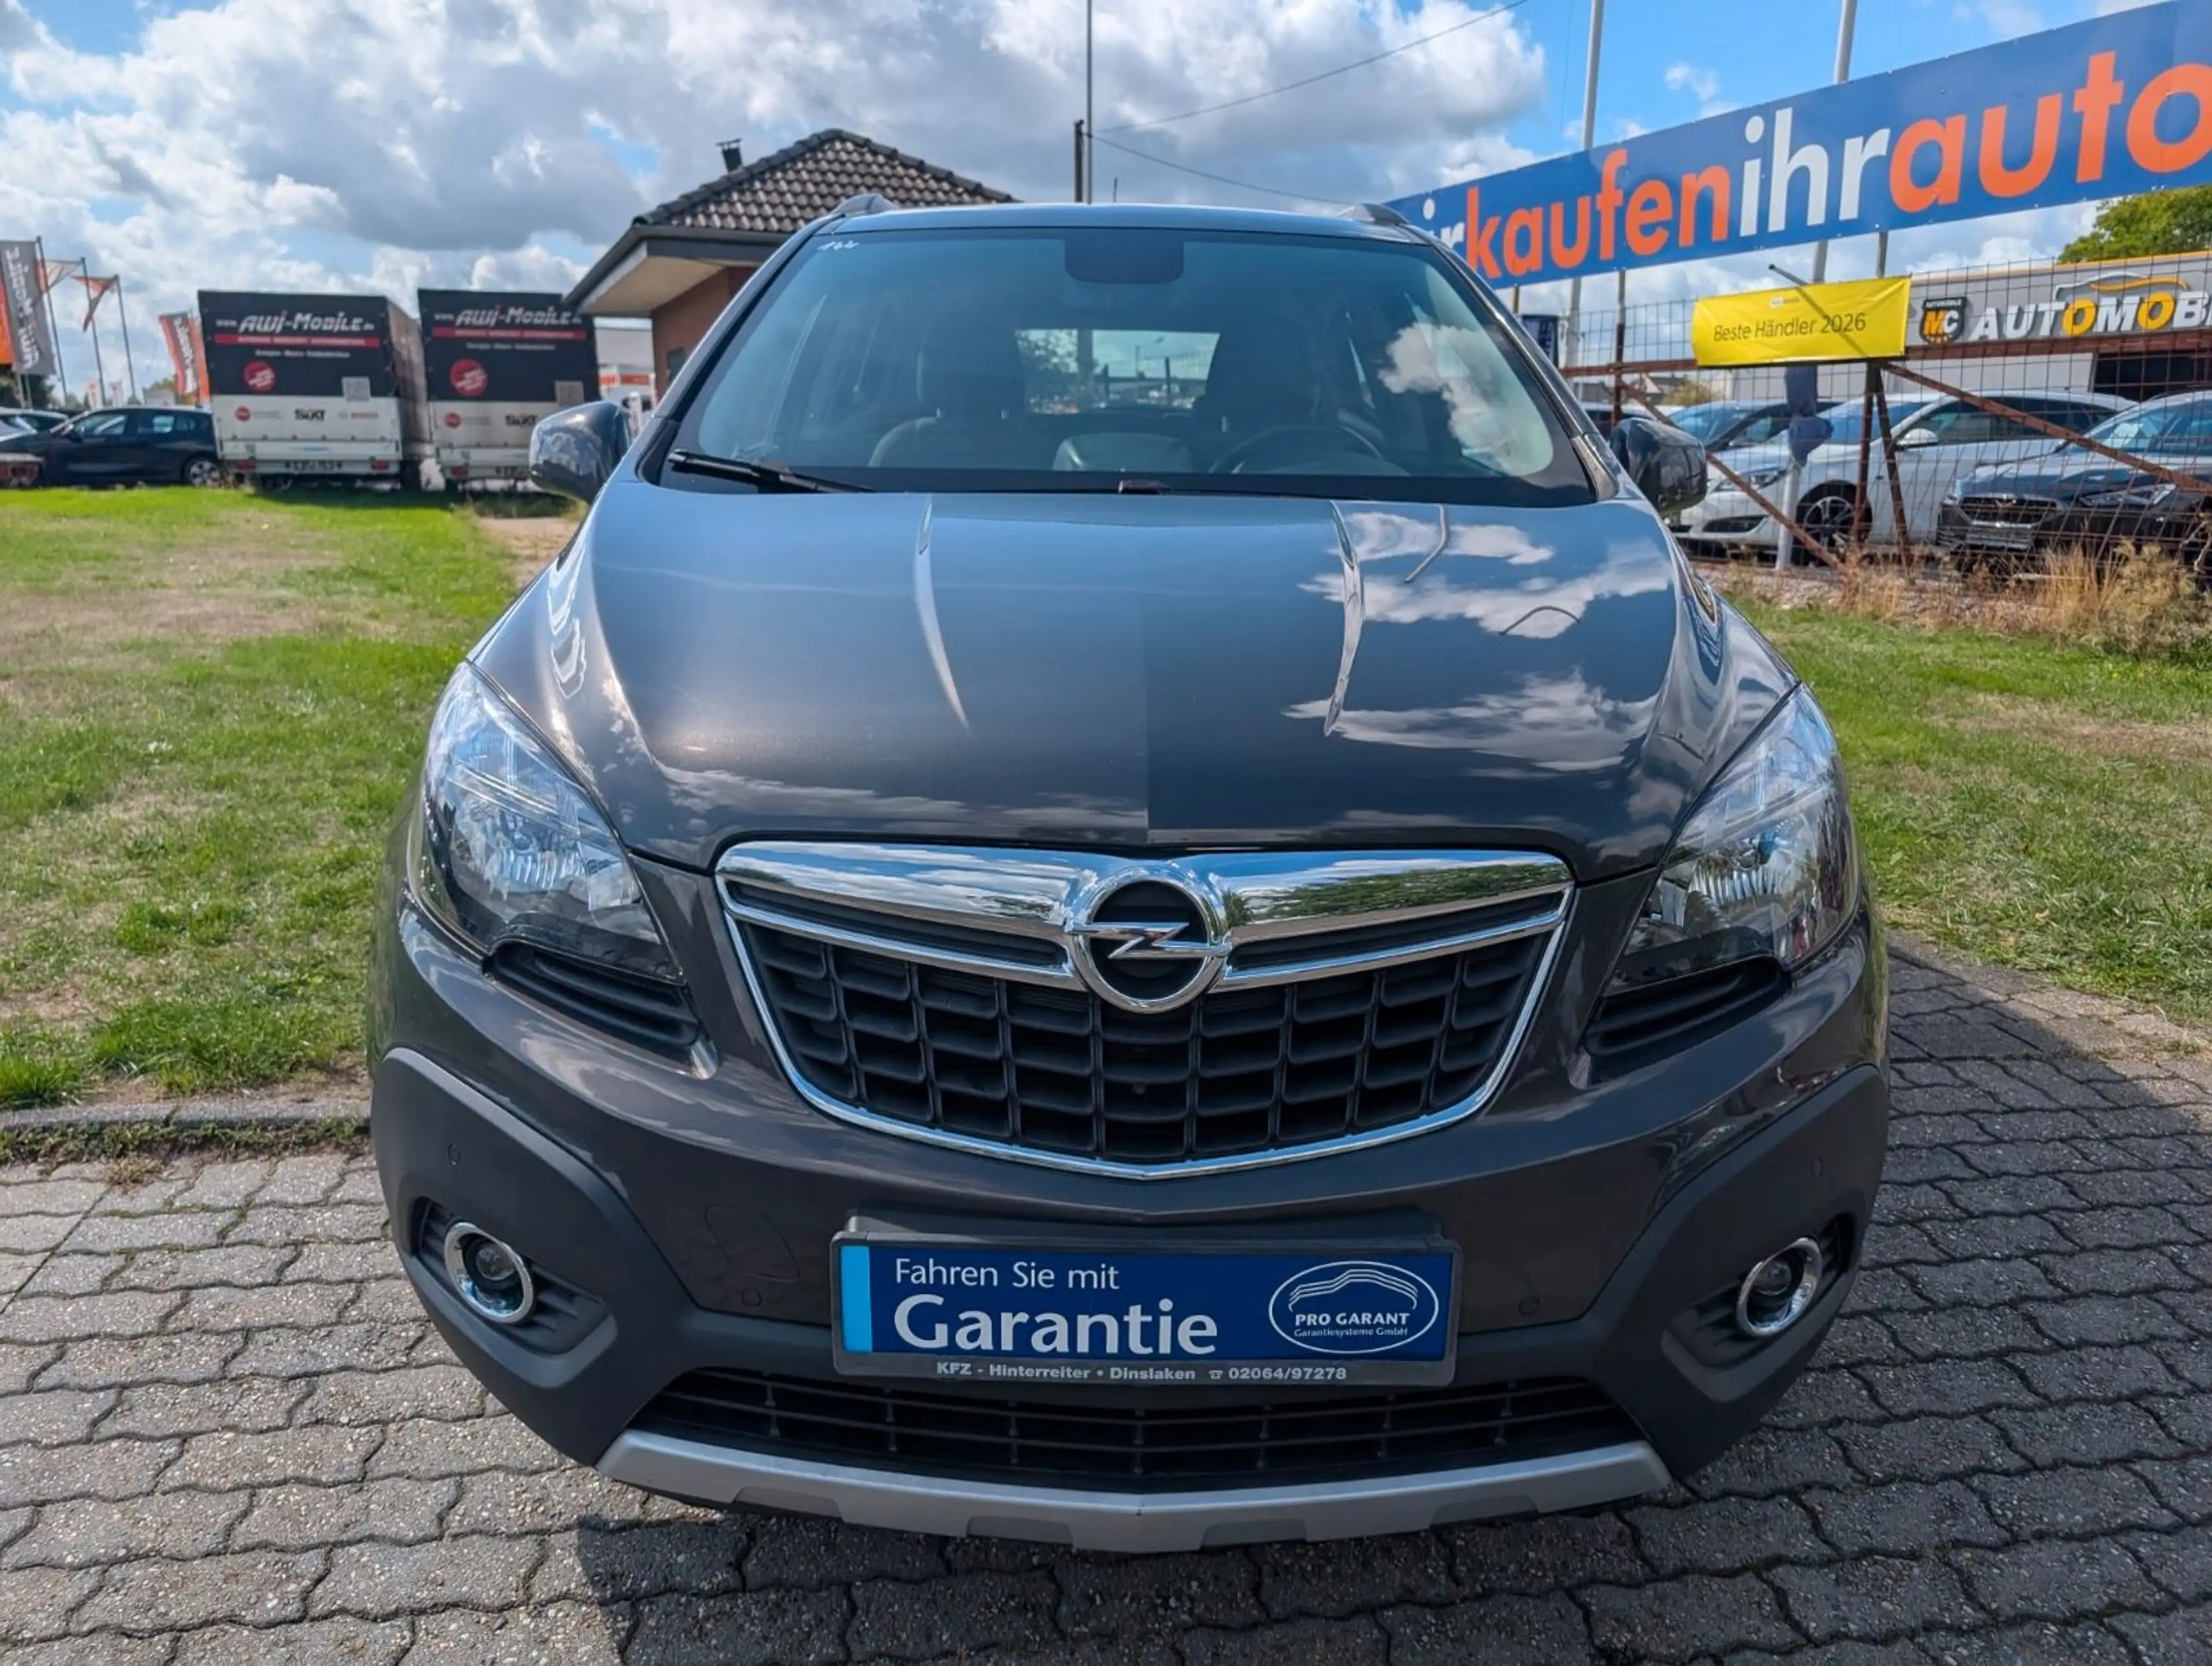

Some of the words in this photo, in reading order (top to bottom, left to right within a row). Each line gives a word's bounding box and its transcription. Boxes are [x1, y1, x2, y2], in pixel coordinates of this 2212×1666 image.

[1713, 324, 1752, 342] Beste
[1754, 318, 1817, 338] Händler
[1820, 312, 1867, 334] 2026
[895, 1258, 998, 1287] Fahren
[1012, 1261, 1055, 1288] Sie
[1068, 1262, 1120, 1289] mit
[894, 1293, 1217, 1355] Garantie
[1295, 1313, 1331, 1326] PRO
[1335, 1312, 1411, 1326] GARANT
[1294, 1328, 1374, 1339] Garantiesysteme
[1376, 1326, 1408, 1336] GmbH
[937, 1362, 972, 1376] KFZ
[989, 1363, 1091, 1379] Hinterreiter
[1109, 1367, 1196, 1380] Dinslaken
[1228, 1368, 1348, 1380] 02064/97278
